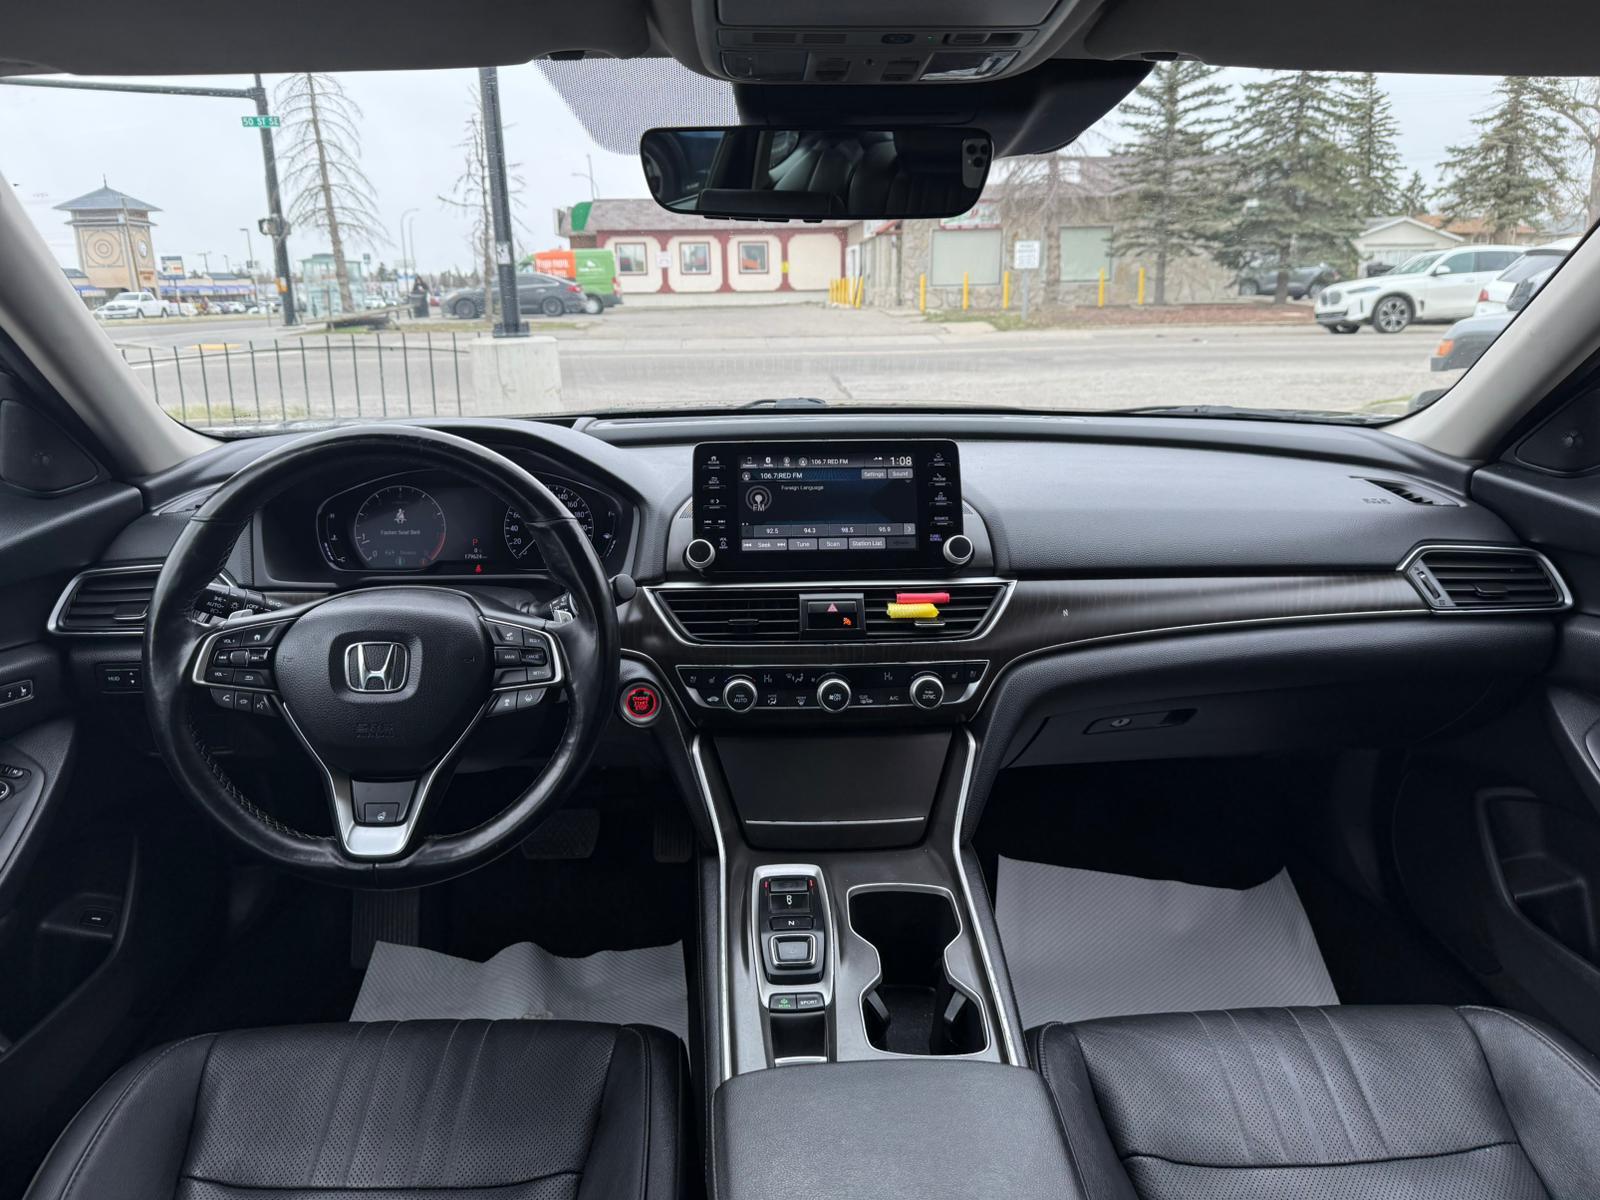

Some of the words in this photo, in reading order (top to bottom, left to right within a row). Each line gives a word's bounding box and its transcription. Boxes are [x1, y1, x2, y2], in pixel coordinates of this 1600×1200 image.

[890, 456, 912, 466] 1:08
[753, 503, 765, 512] FM
[472, 538, 478, 546] P
[513, 537, 522, 545] 20
